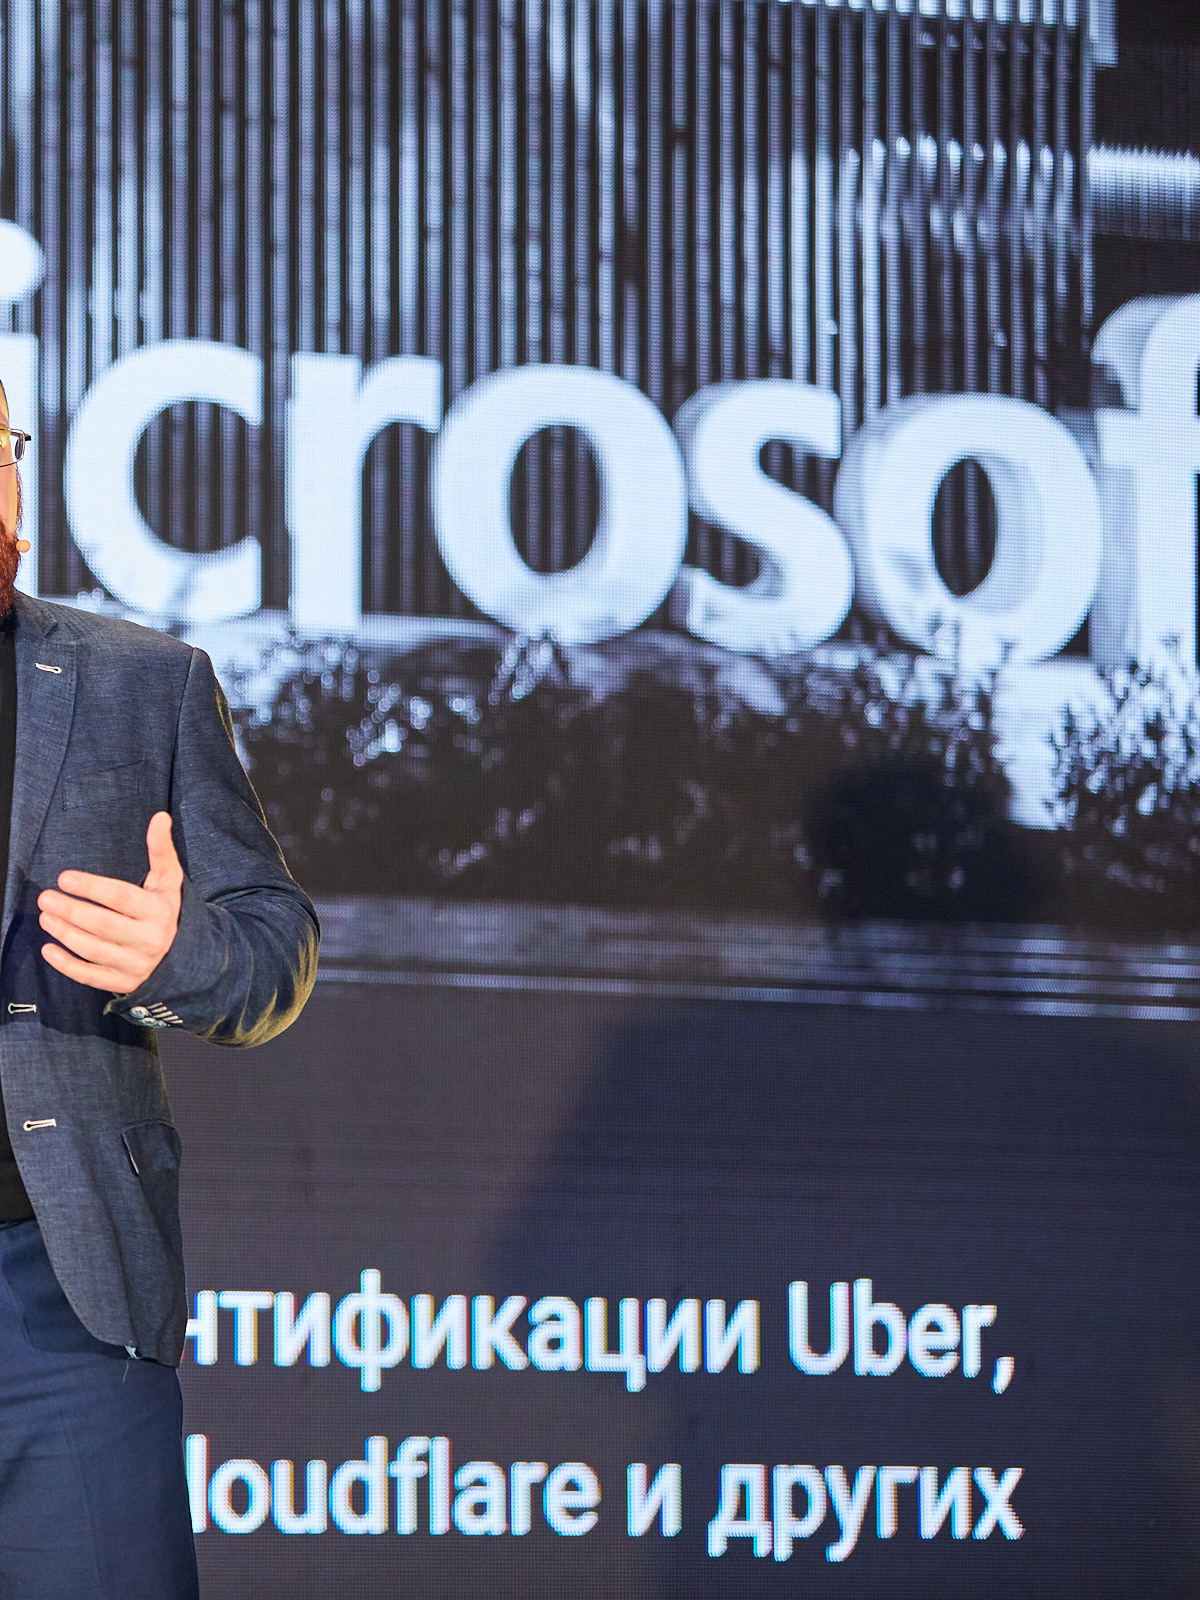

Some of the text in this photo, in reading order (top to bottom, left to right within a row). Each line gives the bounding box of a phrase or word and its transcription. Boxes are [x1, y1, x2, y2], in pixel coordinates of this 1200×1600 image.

[788, 1278, 1015, 1394] Uber,
[627, 1462, 682, 1537] и
[707, 1462, 1025, 1563] других
